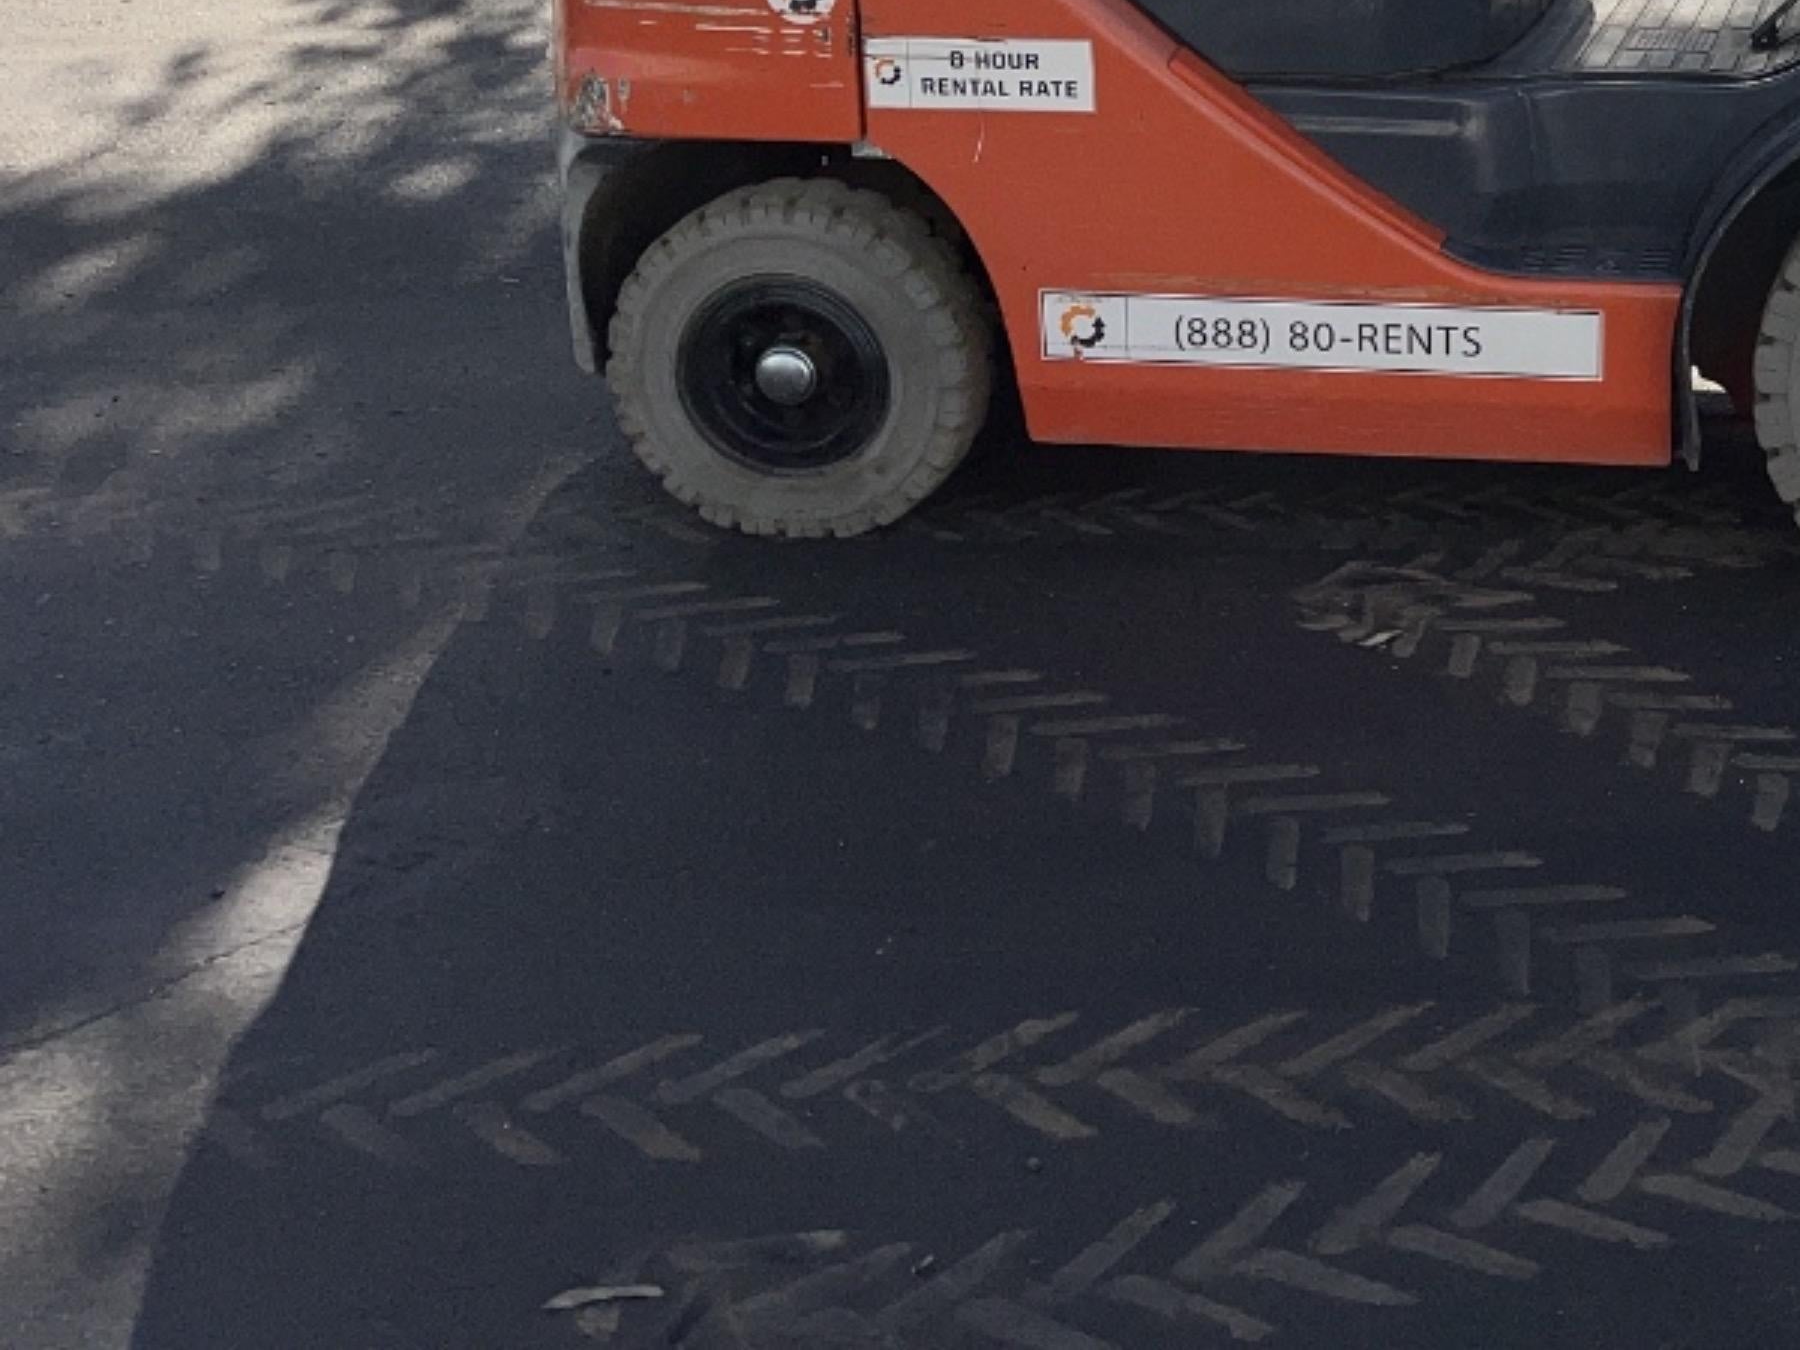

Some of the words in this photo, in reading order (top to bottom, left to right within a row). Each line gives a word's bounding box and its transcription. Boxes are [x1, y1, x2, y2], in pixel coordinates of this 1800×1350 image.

[974, 51, 1040, 70] HOUR
[920, 77, 1010, 97] RENTAL
[1019, 80, 1078, 99] RATE
[1174, 315, 1271, 353] (888)
[1288, 319, 1483, 358] 80-RENTS
